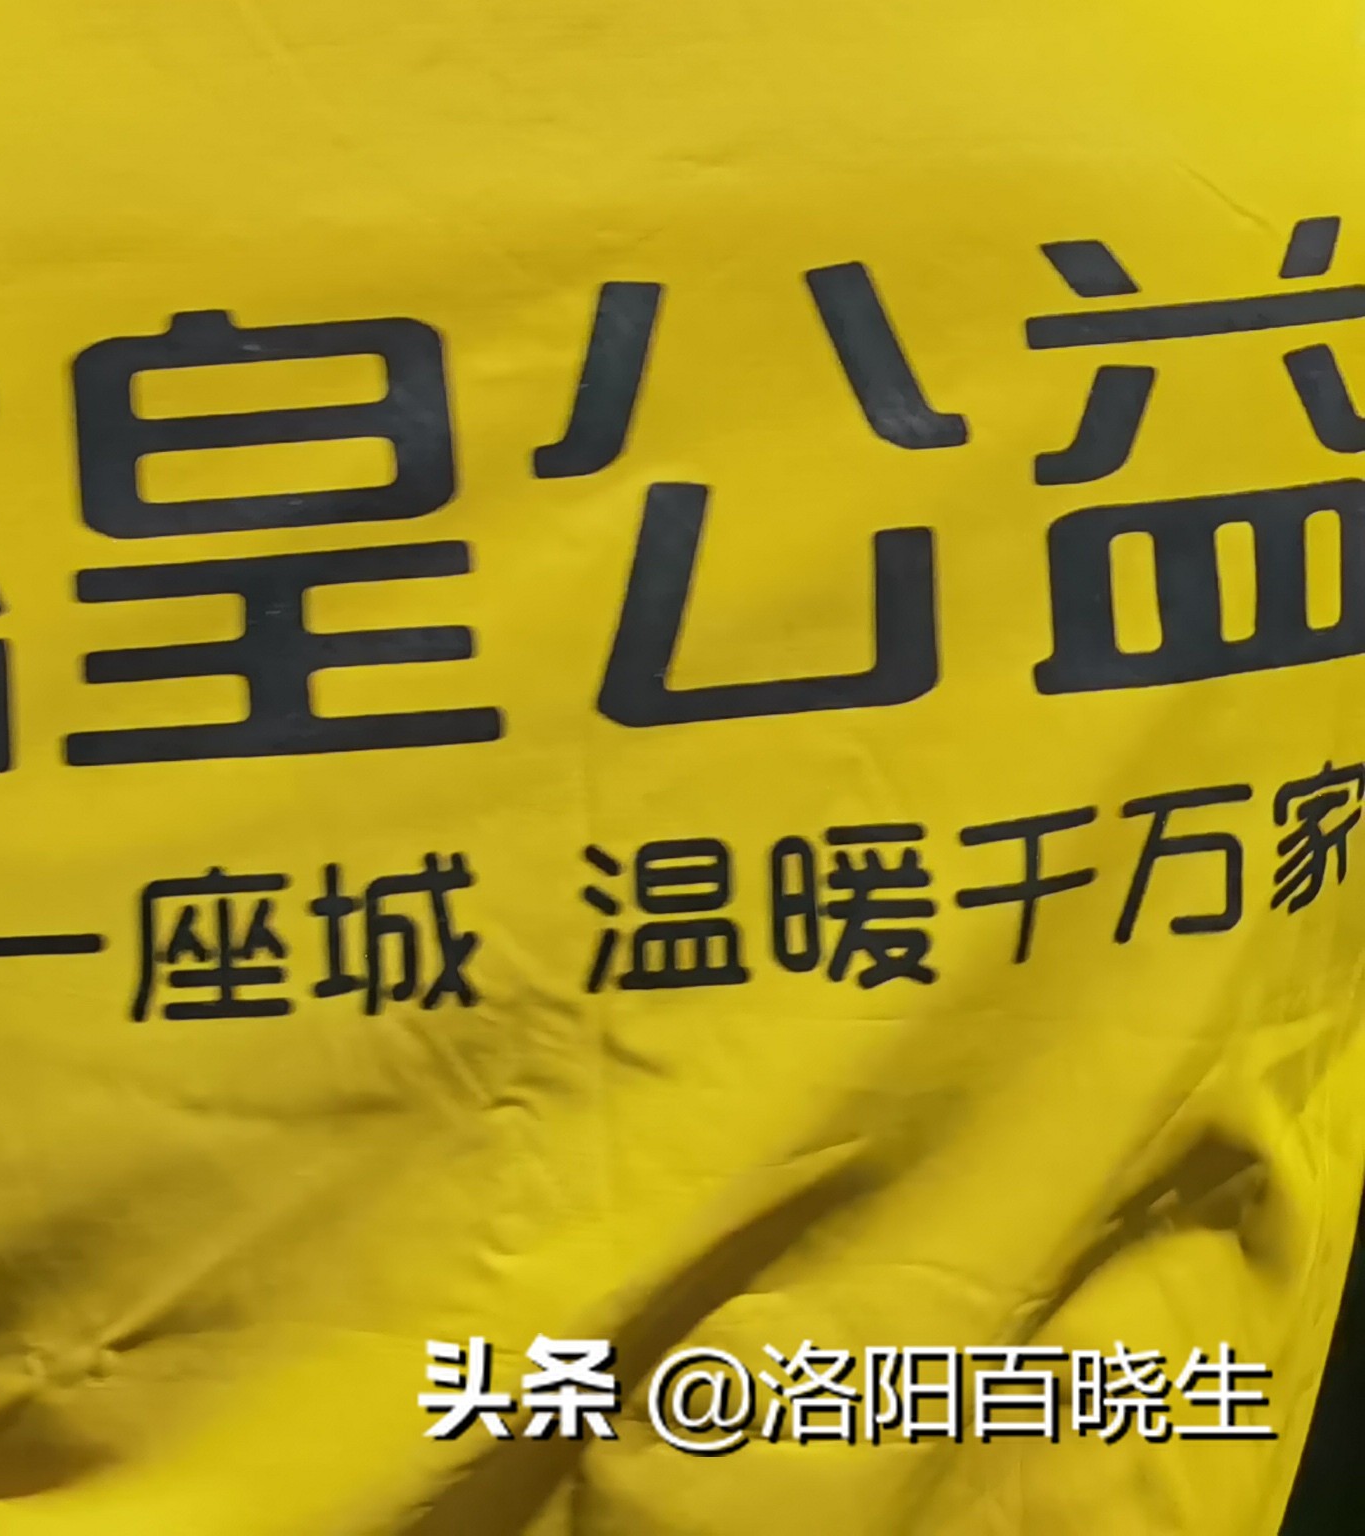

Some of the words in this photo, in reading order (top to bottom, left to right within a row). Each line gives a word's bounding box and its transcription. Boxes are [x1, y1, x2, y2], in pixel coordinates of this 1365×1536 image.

[581, 760, 1365, 994] 温暖千万家
